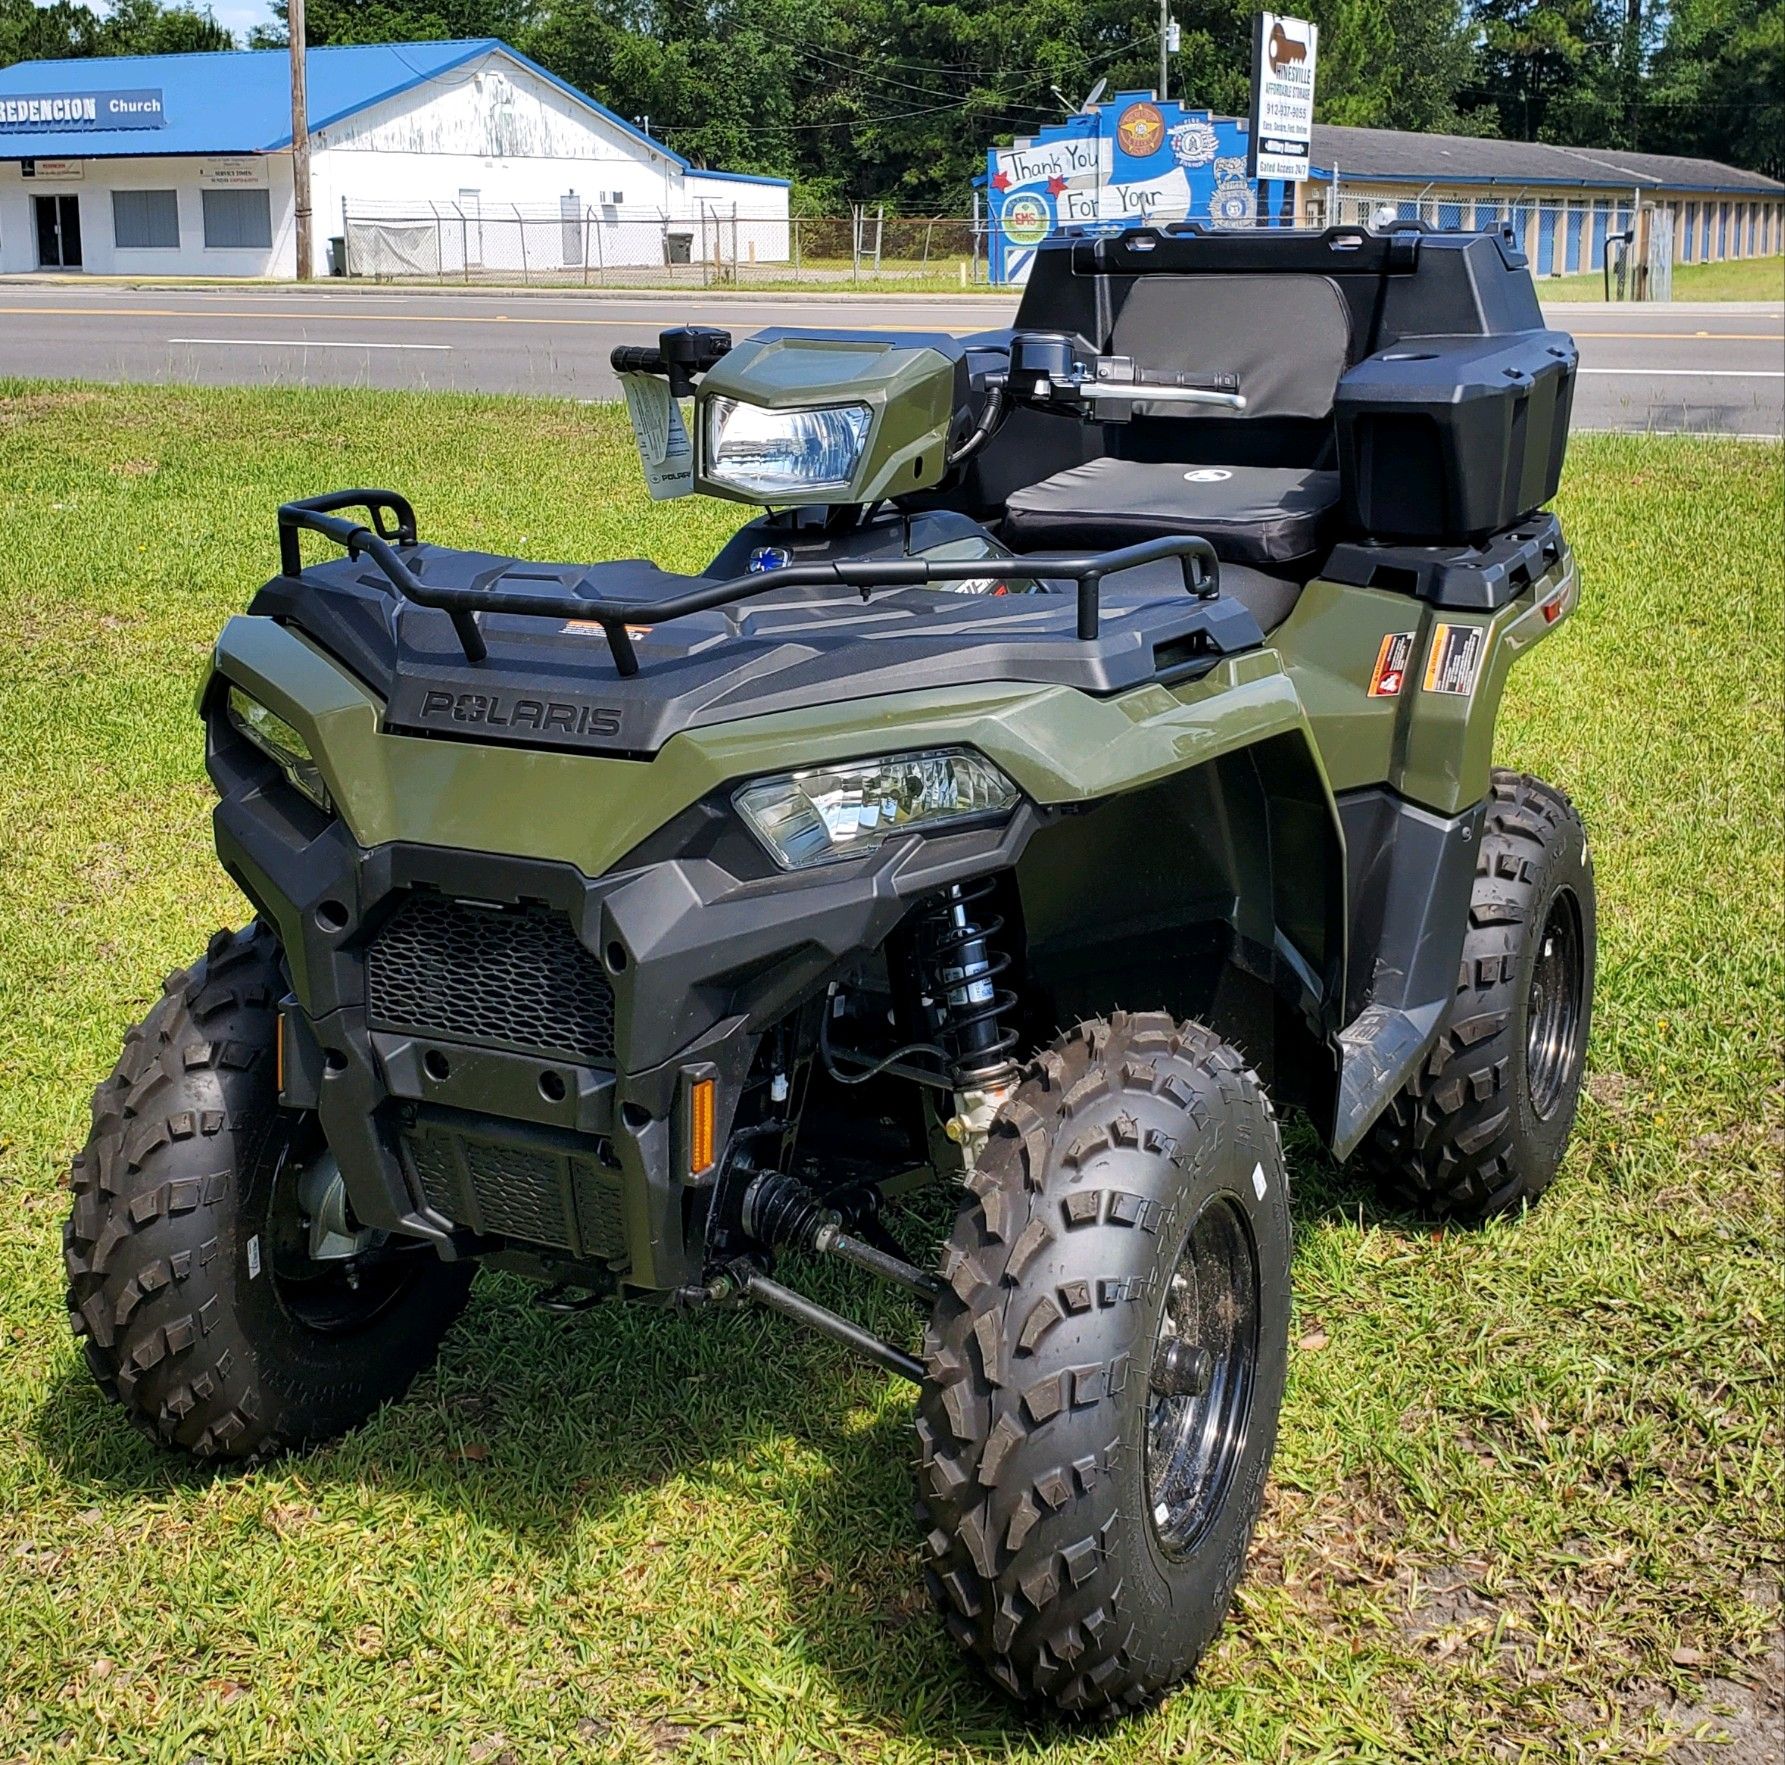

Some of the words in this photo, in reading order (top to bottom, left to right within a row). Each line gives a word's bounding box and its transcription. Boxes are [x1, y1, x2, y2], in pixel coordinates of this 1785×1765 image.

[1276, 64, 1311, 85] HINESVILLE
[109, 98, 161, 112] Church
[1000, 151, 1063, 181] Thank
[1065, 145, 1099, 171] You
[1068, 192, 1099, 219] For
[1015, 213, 1036, 225] EMS
[419, 690, 622, 737] POLARIS
